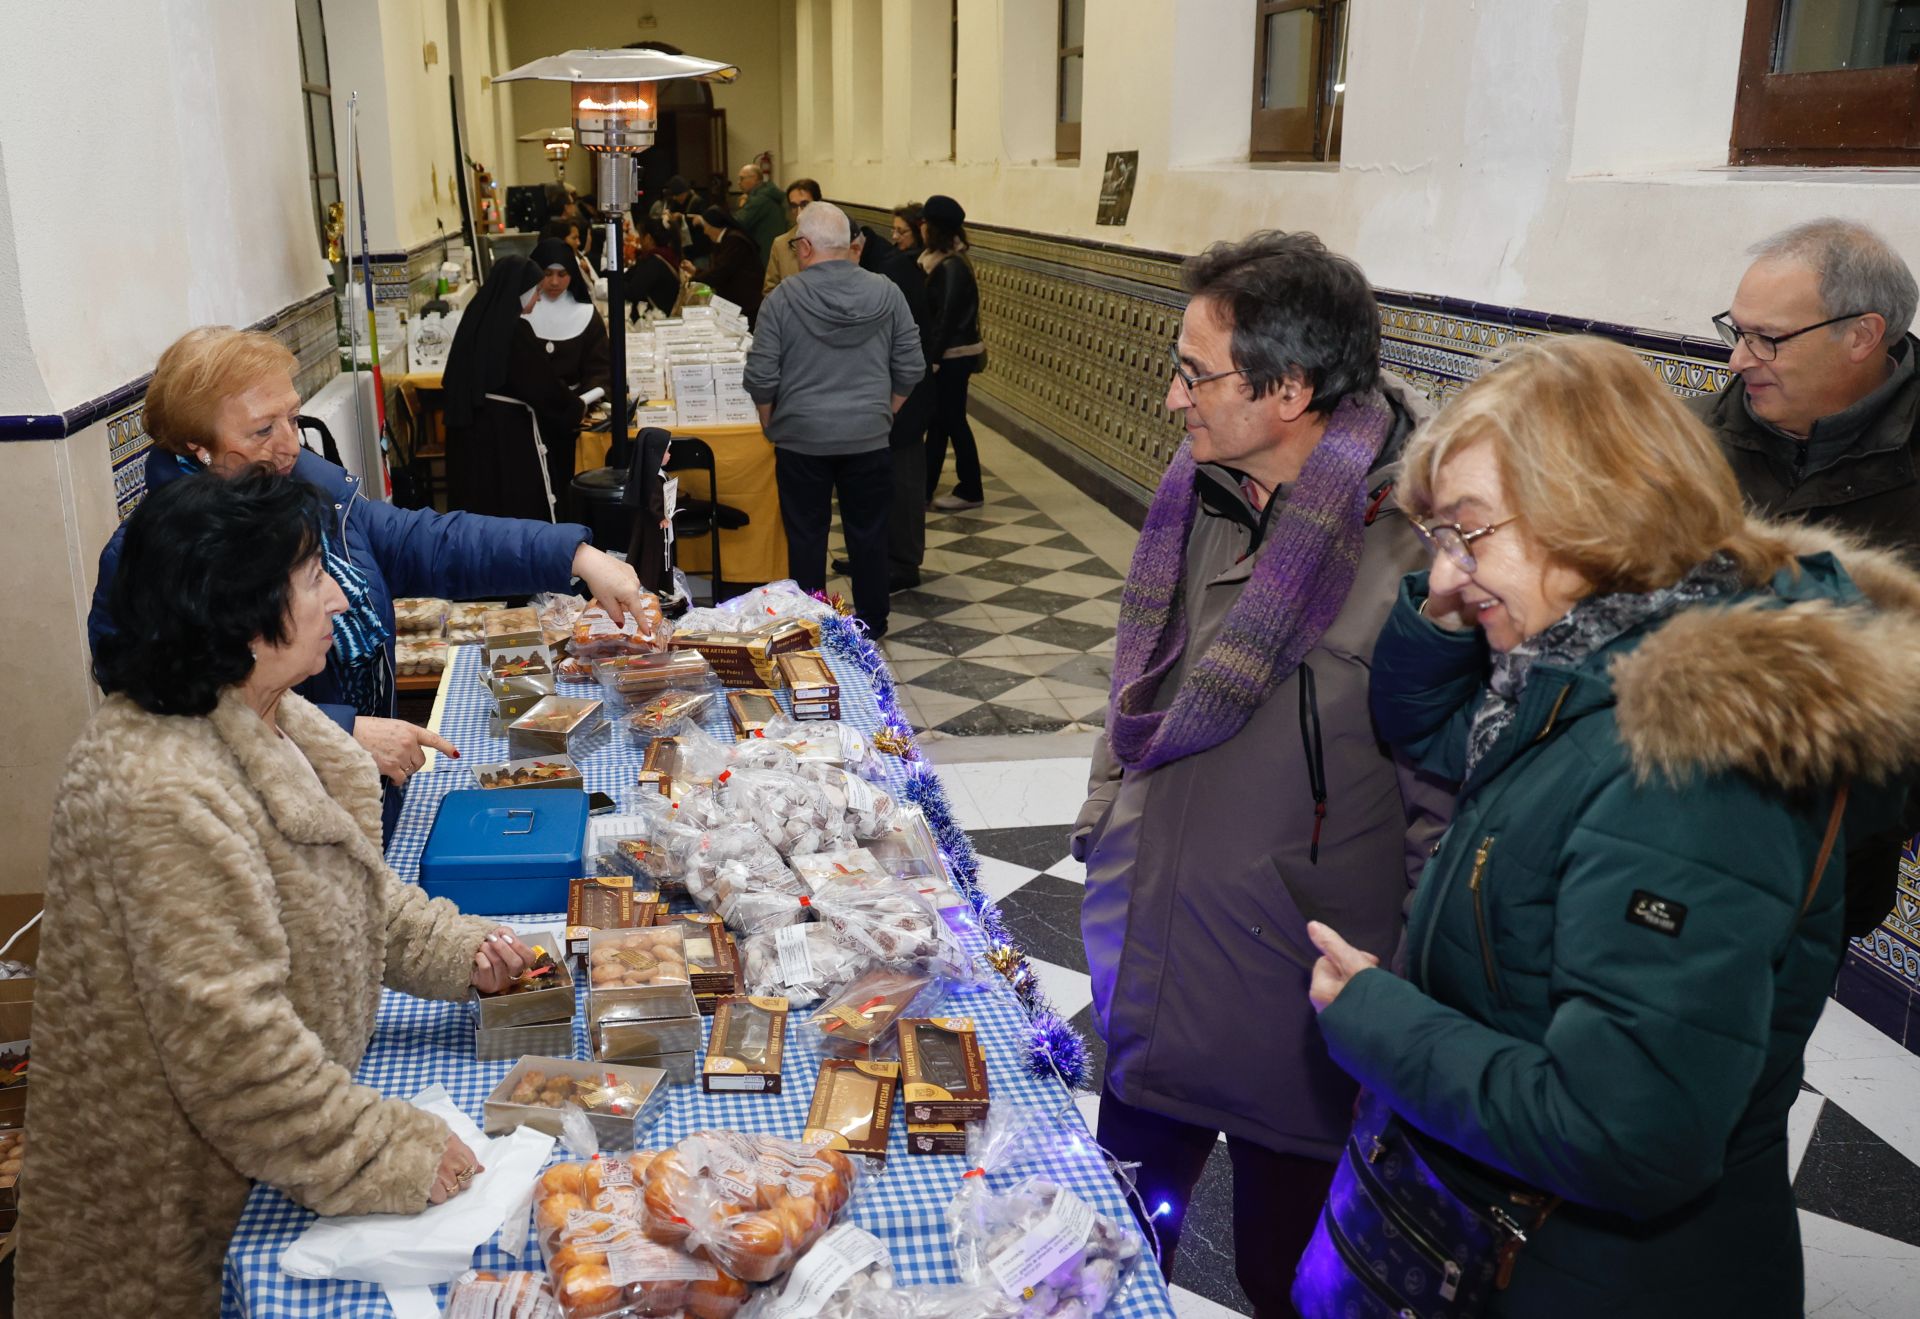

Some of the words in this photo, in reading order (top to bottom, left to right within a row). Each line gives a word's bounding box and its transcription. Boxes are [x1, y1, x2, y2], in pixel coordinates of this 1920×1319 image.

[904, 1034, 914, 1052] TURRÓN
[905, 1052, 917, 1077] ARTESANO
[879, 1083, 890, 1109] ARTESANO
[875, 1108, 886, 1129] TURRÓN
